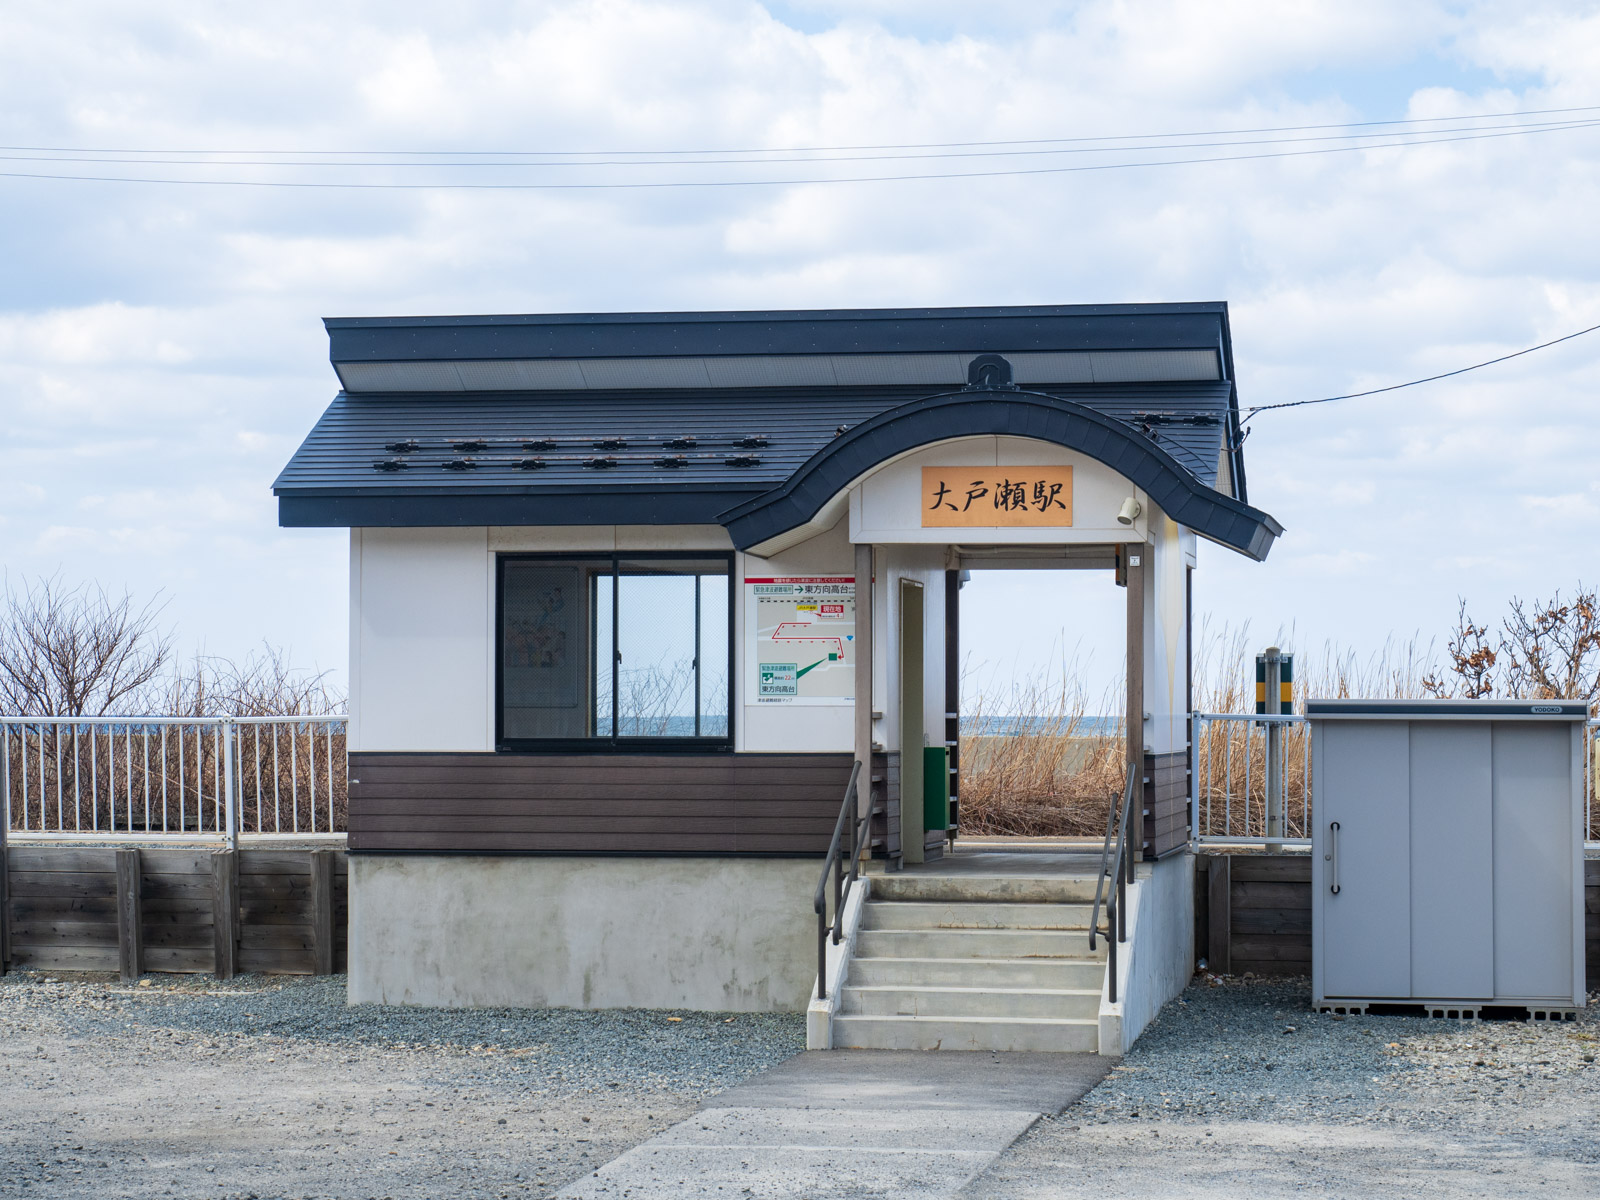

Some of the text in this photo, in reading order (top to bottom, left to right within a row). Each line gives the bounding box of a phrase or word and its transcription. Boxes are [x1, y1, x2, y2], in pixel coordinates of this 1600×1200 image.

[929, 479, 1066, 512] 大戸瀬駅
[805, 585, 848, 594] 東方向高台
